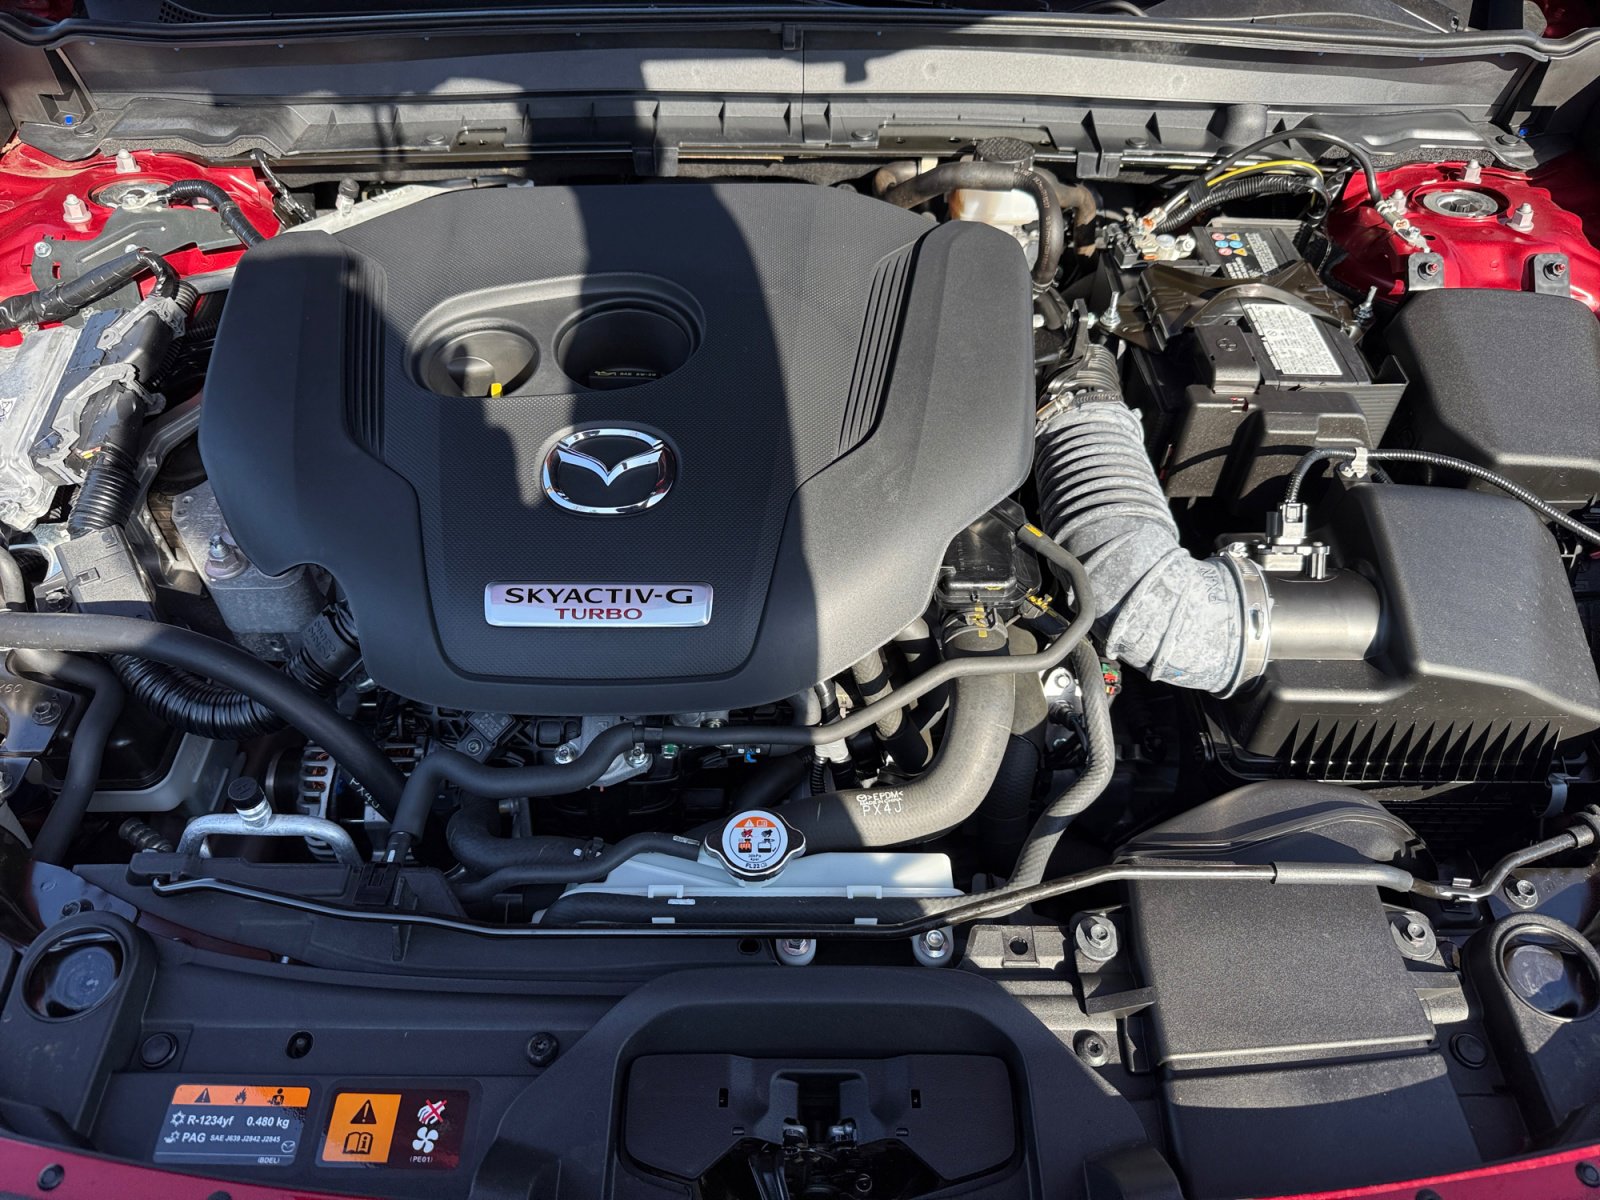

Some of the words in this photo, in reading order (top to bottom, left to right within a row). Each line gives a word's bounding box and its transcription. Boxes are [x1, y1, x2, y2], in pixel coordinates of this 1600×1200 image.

[504, 587, 694, 604] SKYACTIV-G
[554, 607, 643, 620] TURBO
[186, 1114, 235, 1128] R-1234yf
[246, 1116, 274, 1127] 0.480
[275, 1116, 290, 1129] kg
[181, 1132, 206, 1143] PAG
[210, 1134, 225, 1142] SAE
[225, 1134, 241, 1142] J639
